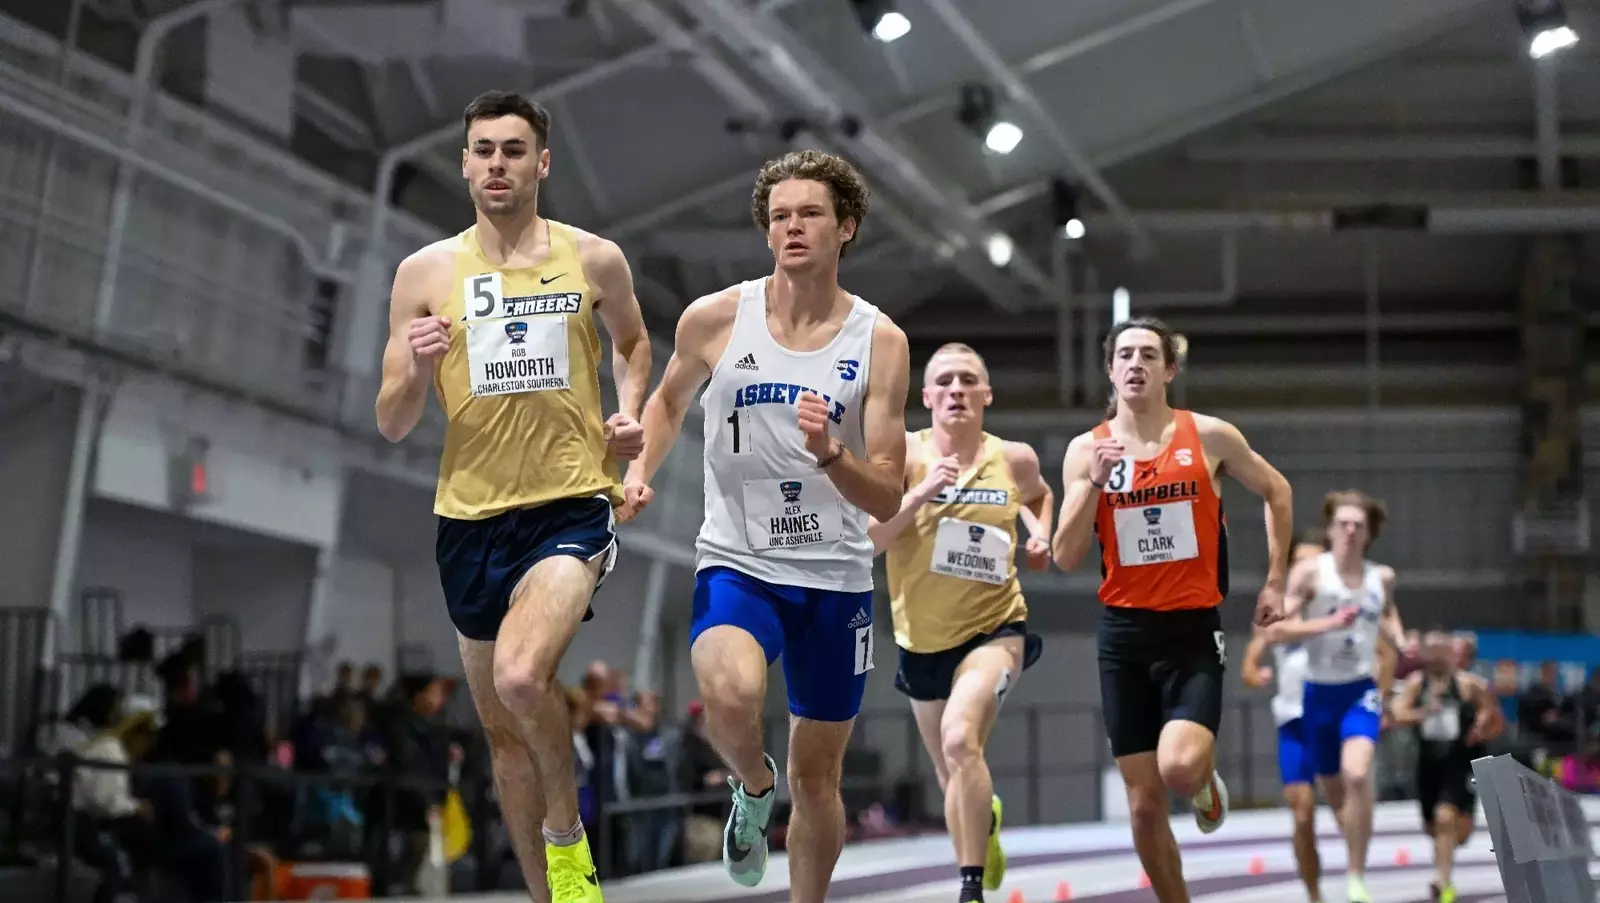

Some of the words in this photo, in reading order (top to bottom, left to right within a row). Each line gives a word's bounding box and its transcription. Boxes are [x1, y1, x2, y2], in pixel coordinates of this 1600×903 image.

[473, 276, 495, 317] 5
[502, 292, 581, 317] CANEERS
[512, 348, 526, 357] ROB
[485, 357, 555, 380] HOWORTH
[735, 362, 759, 371] adidas
[477, 380, 525, 395] CHARLESTON
[526, 378, 564, 389] SOUTHERN
[727, 410, 740, 453] 1
[1109, 459, 1126, 490] 3
[1106, 481, 1200, 508] CAMPBELL
[785, 505, 802, 516] ALEX
[770, 513, 820, 535] HAINES
[769, 536, 784, 547] UNC
[785, 532, 823, 545] ASHEVILLE
[1138, 536, 1175, 553] CLARK
[947, 550, 996, 572] WEDDING
[860, 628, 870, 671] 1
